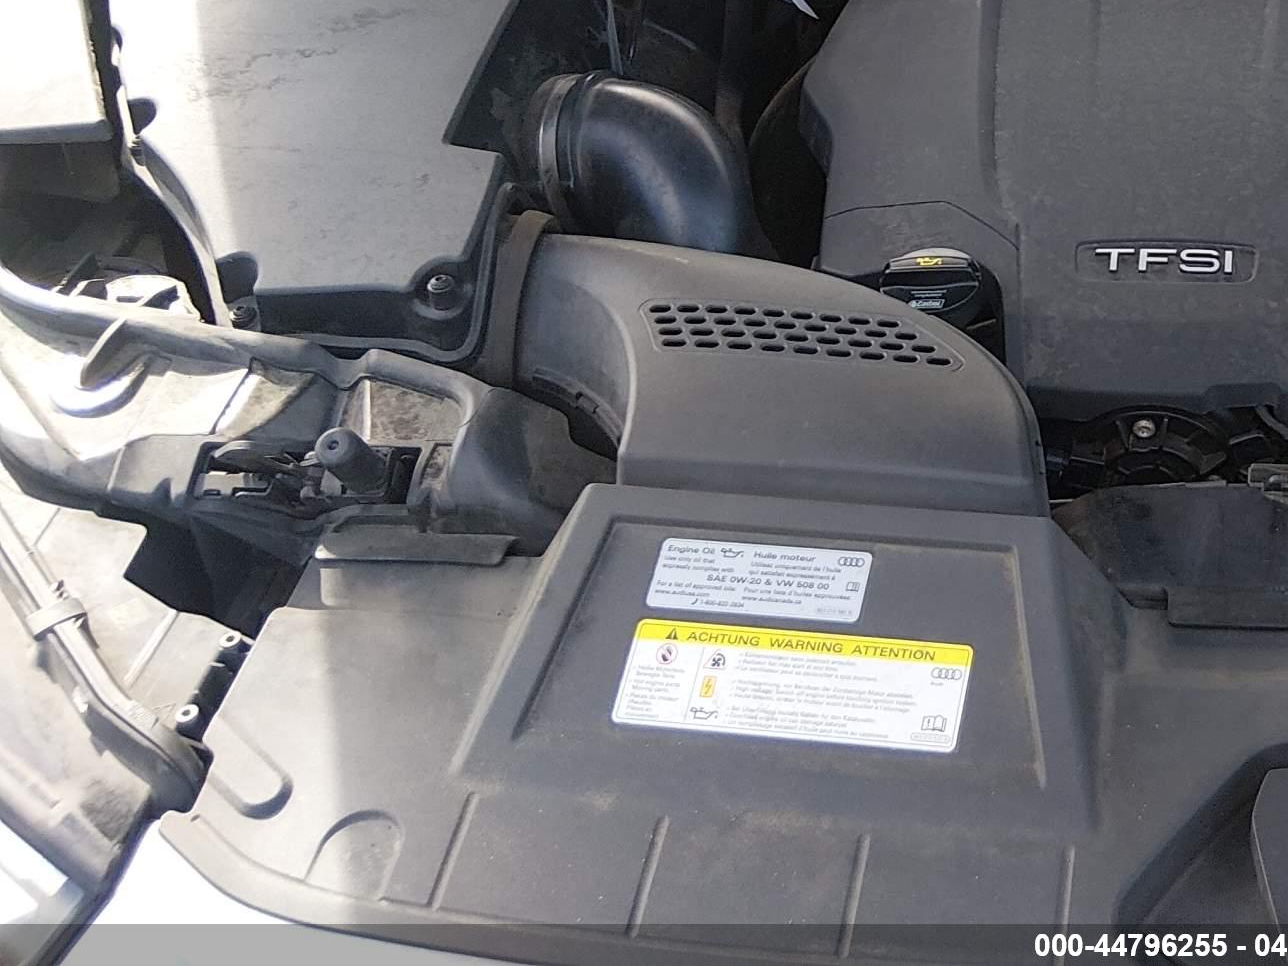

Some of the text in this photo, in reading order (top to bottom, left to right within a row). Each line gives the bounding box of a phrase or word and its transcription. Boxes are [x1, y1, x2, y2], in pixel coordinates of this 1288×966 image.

[1095, 248, 1234, 274] TFSI
[666, 544, 700, 554] Engine
[753, 550, 816, 562] Huile moteur
[686, 631, 760, 646] ACHTUNG
[769, 638, 844, 654] WARNING
[851, 644, 936, 662] ATTENTION
